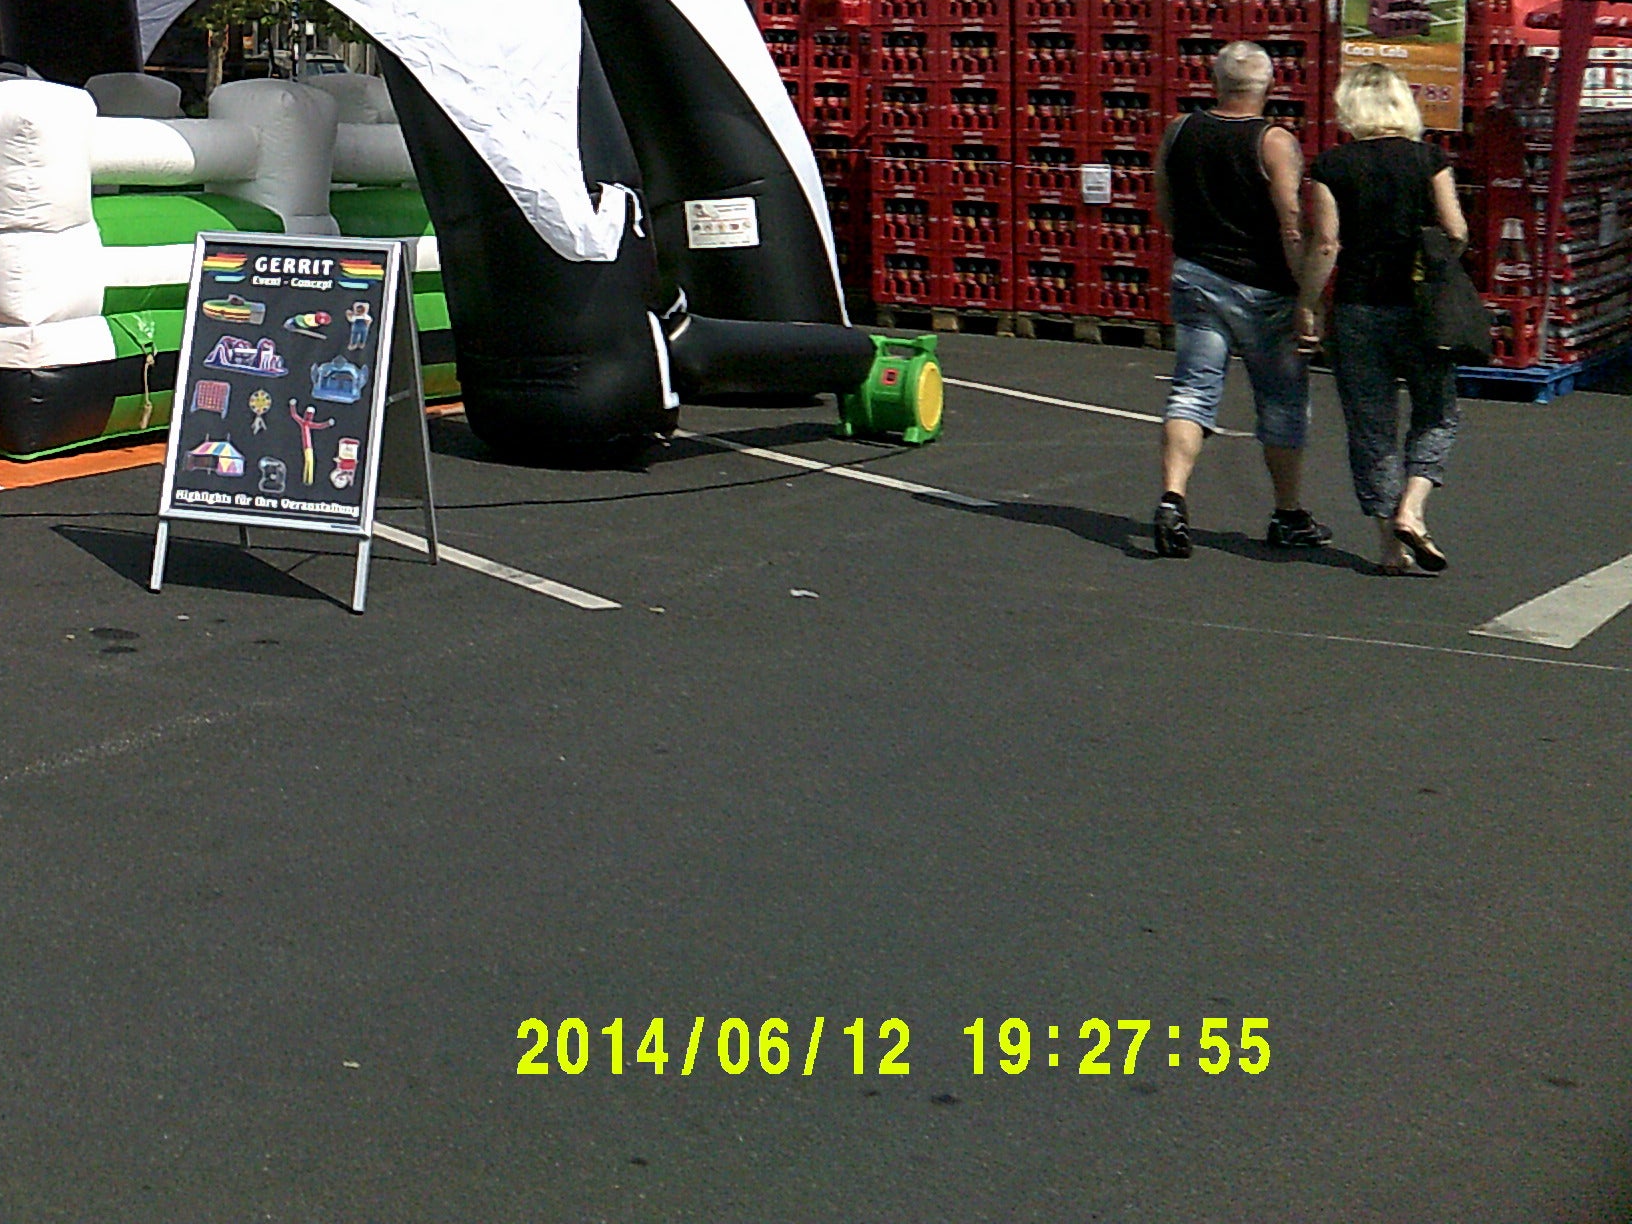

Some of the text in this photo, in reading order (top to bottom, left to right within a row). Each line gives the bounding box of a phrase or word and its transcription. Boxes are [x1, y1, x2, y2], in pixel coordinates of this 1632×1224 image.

[1345, 43, 1408, 58] Coca Cola
[254, 256, 334, 276] GERRIT
[252, 275, 282, 287] Event
[290, 277, 333, 291] Concept
[175, 489, 232, 505] Highlights
[234, 493, 253, 506] für
[280, 498, 360, 518] Veranstaltung
